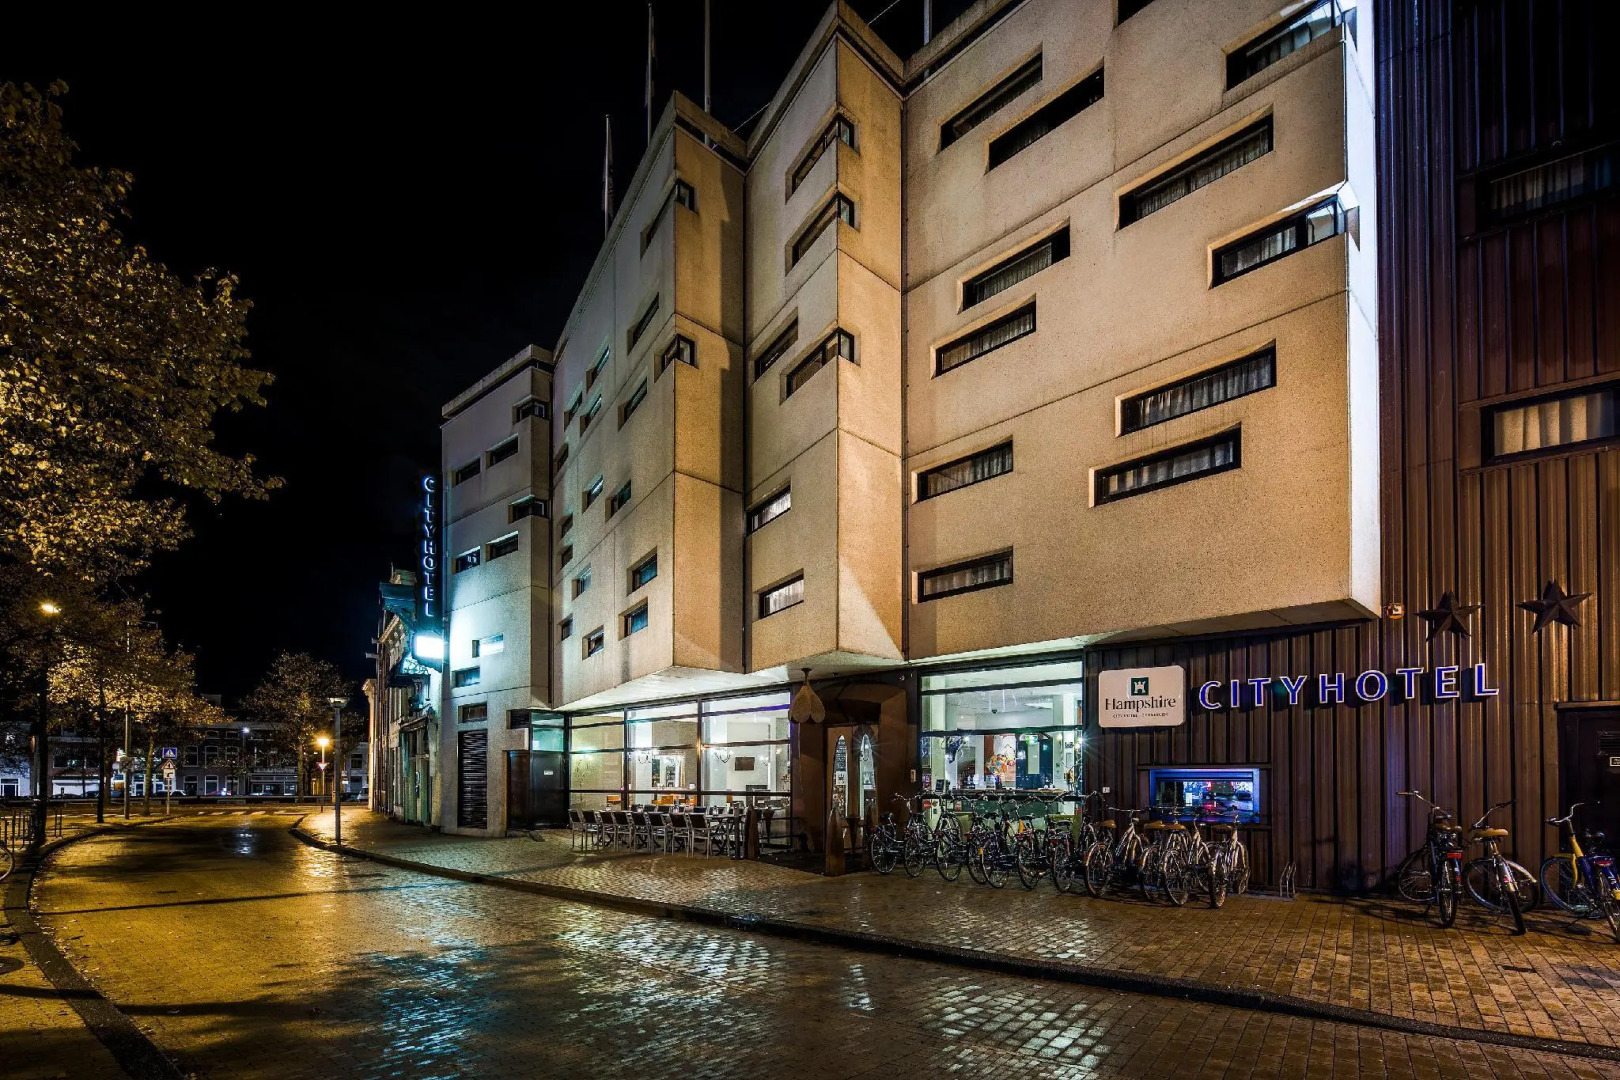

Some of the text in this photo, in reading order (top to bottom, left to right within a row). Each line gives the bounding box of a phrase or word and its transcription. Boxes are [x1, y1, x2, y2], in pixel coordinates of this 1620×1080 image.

[423, 476, 437, 618] CITYHOTEL
[1105, 696, 1176, 712] Hampshire
[1199, 663, 1499, 709] CITYHOTEL
